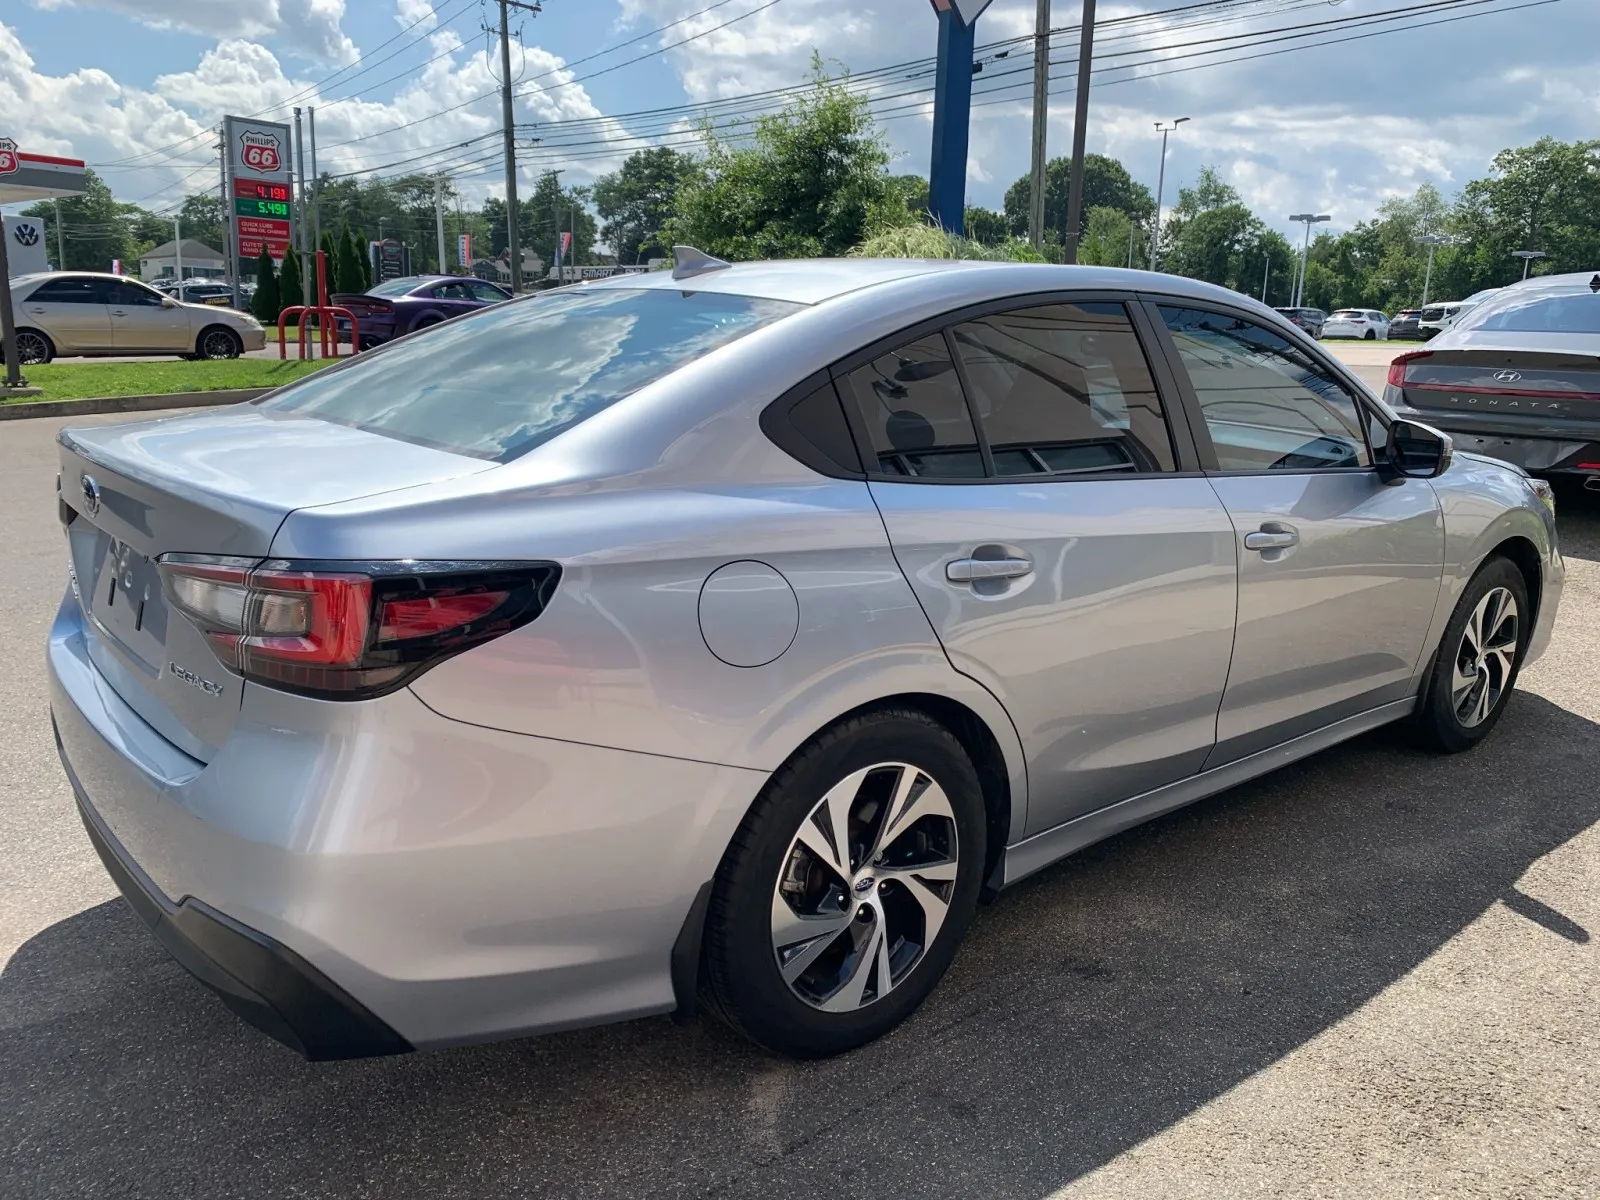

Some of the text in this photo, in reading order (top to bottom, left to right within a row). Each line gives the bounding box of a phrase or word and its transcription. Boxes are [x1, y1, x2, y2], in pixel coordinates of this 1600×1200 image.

[246, 136, 275, 147] PHILLIPS
[249, 148, 274, 165] 66
[582, 269, 614, 279] SMART
[1450, 397, 1558, 409] SONATA
[169, 661, 224, 697] LEGACY
